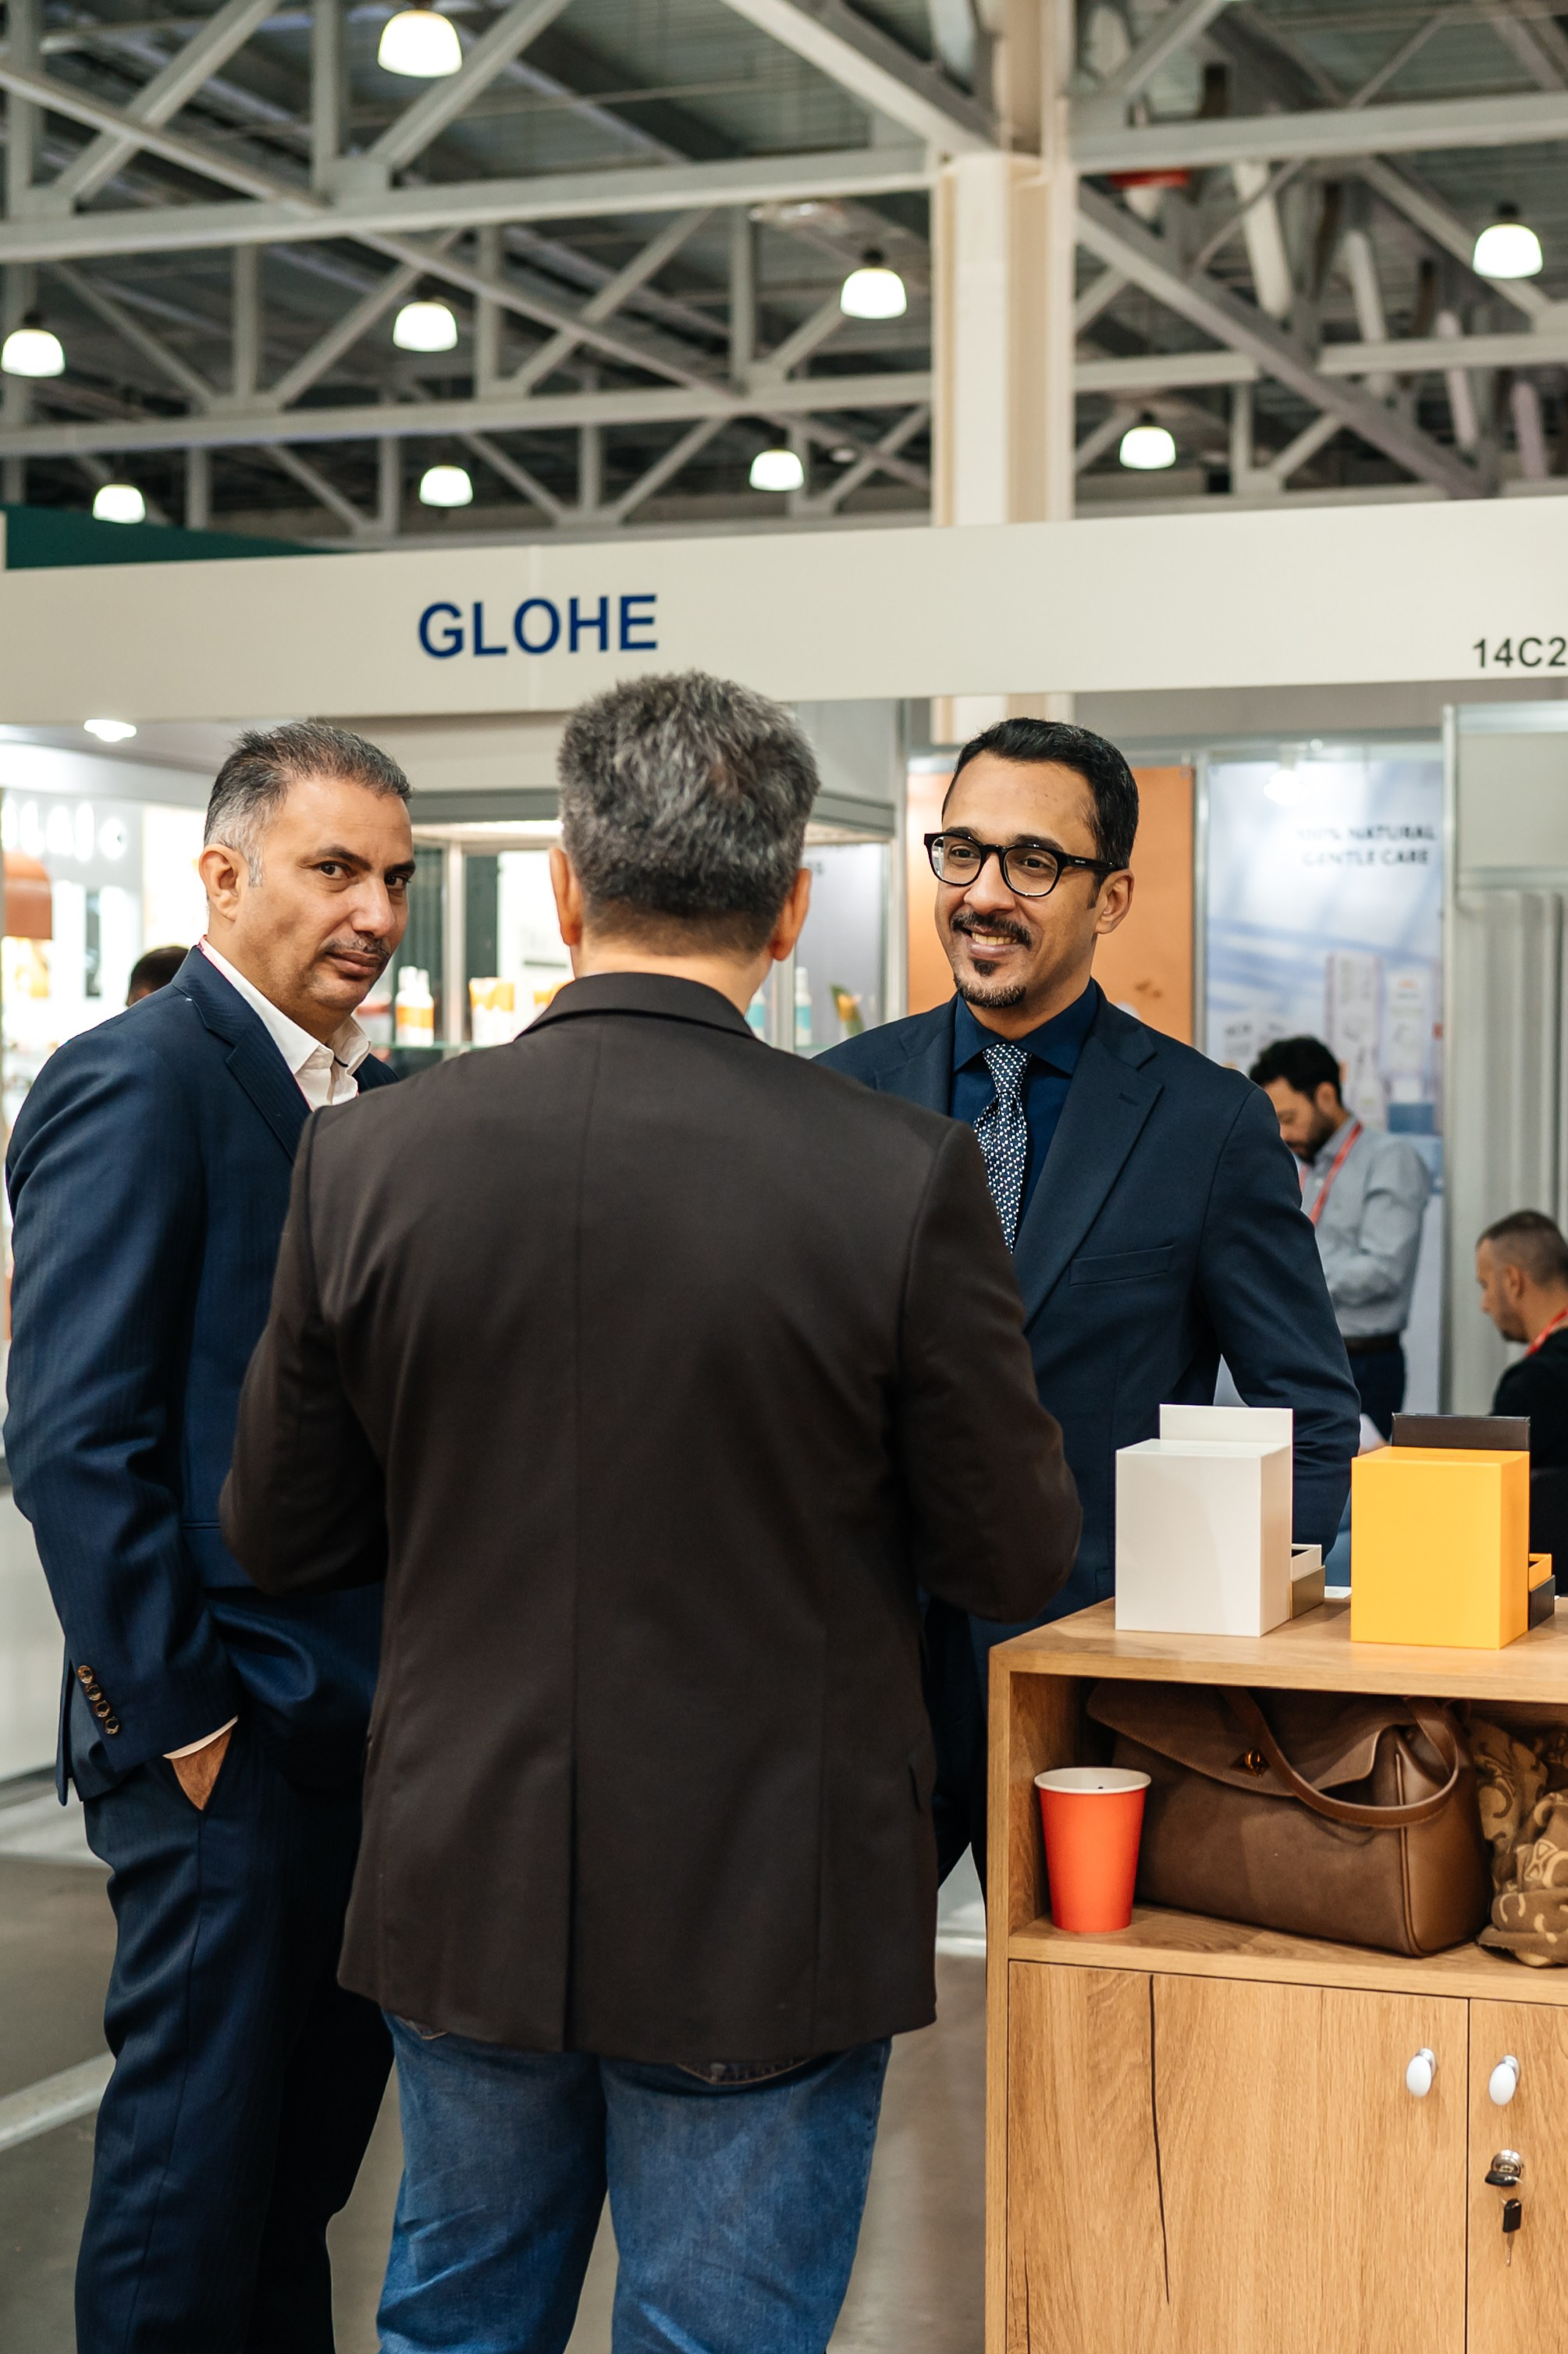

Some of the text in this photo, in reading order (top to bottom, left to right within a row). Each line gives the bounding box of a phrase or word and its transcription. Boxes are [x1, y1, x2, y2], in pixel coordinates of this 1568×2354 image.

[418, 593, 658, 659] GLOHE
[1473, 636, 1566, 668] 14C2
[1348, 823, 1436, 841] NATURAL
[1381, 848, 1428, 866] CARE
